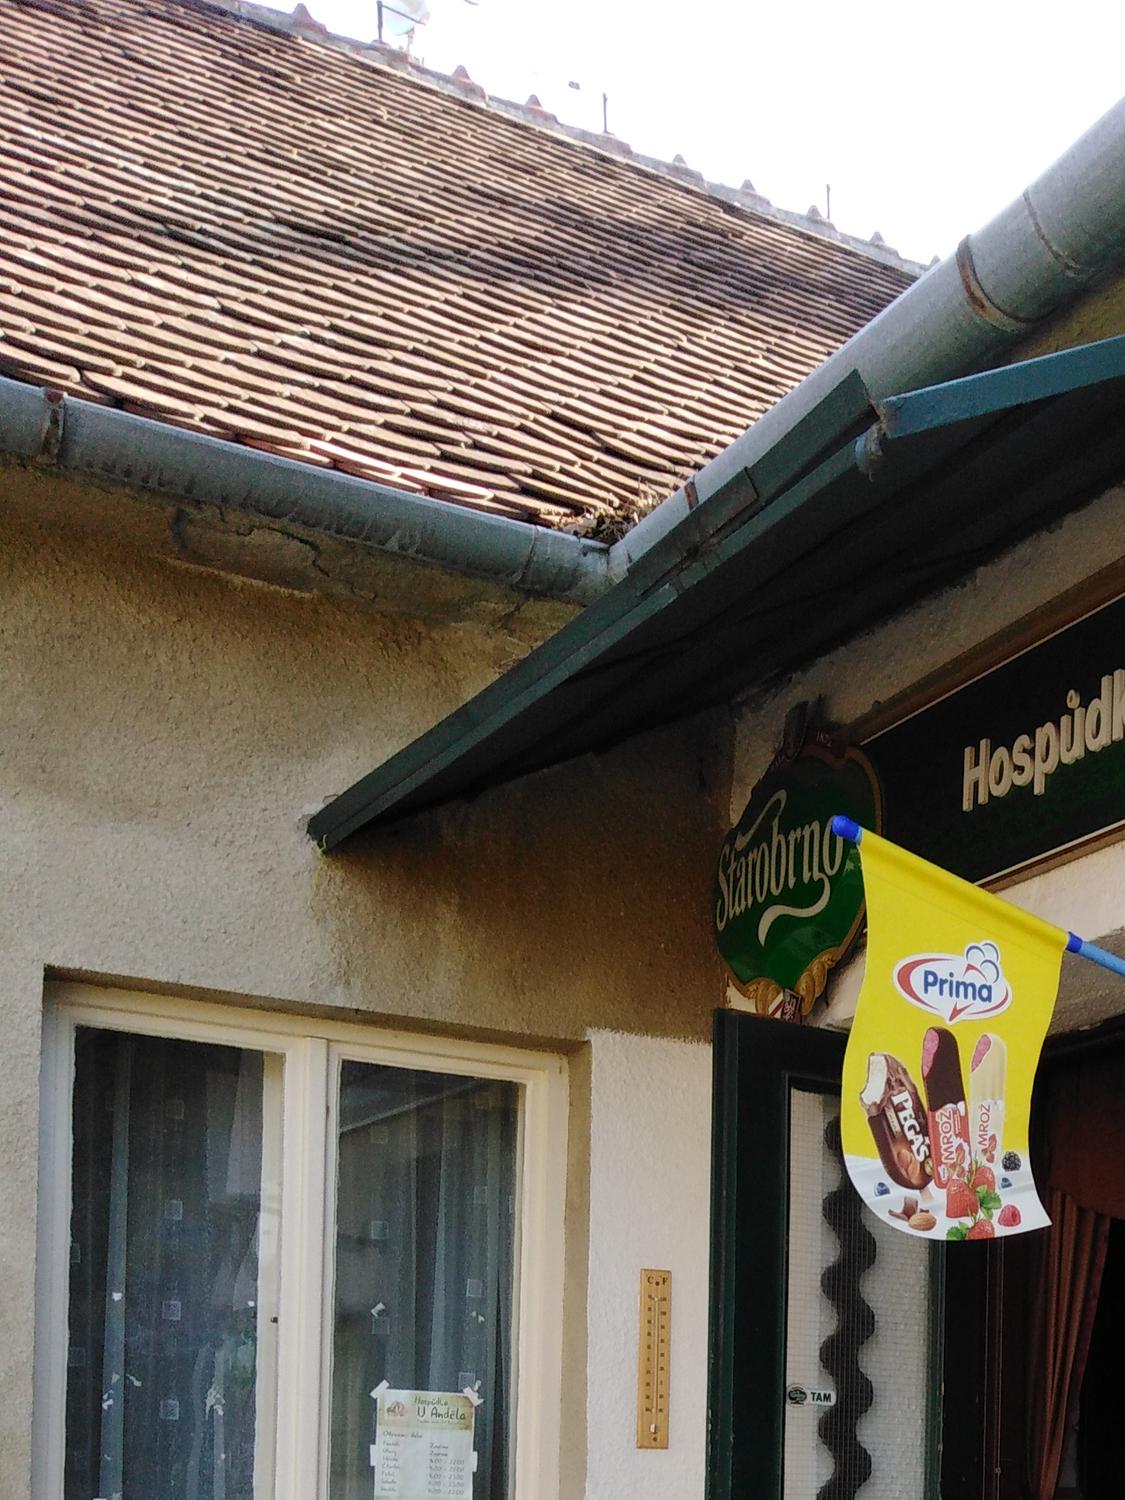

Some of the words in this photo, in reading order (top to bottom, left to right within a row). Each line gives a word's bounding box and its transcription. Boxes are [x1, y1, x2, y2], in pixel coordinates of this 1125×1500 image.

[716, 789, 844, 947] Starobrno
[923, 970, 993, 1003] Prima
[810, 1392, 832, 1402] TAM
[417, 1407, 426, 1418] U
[431, 1408, 466, 1421] Anděla
